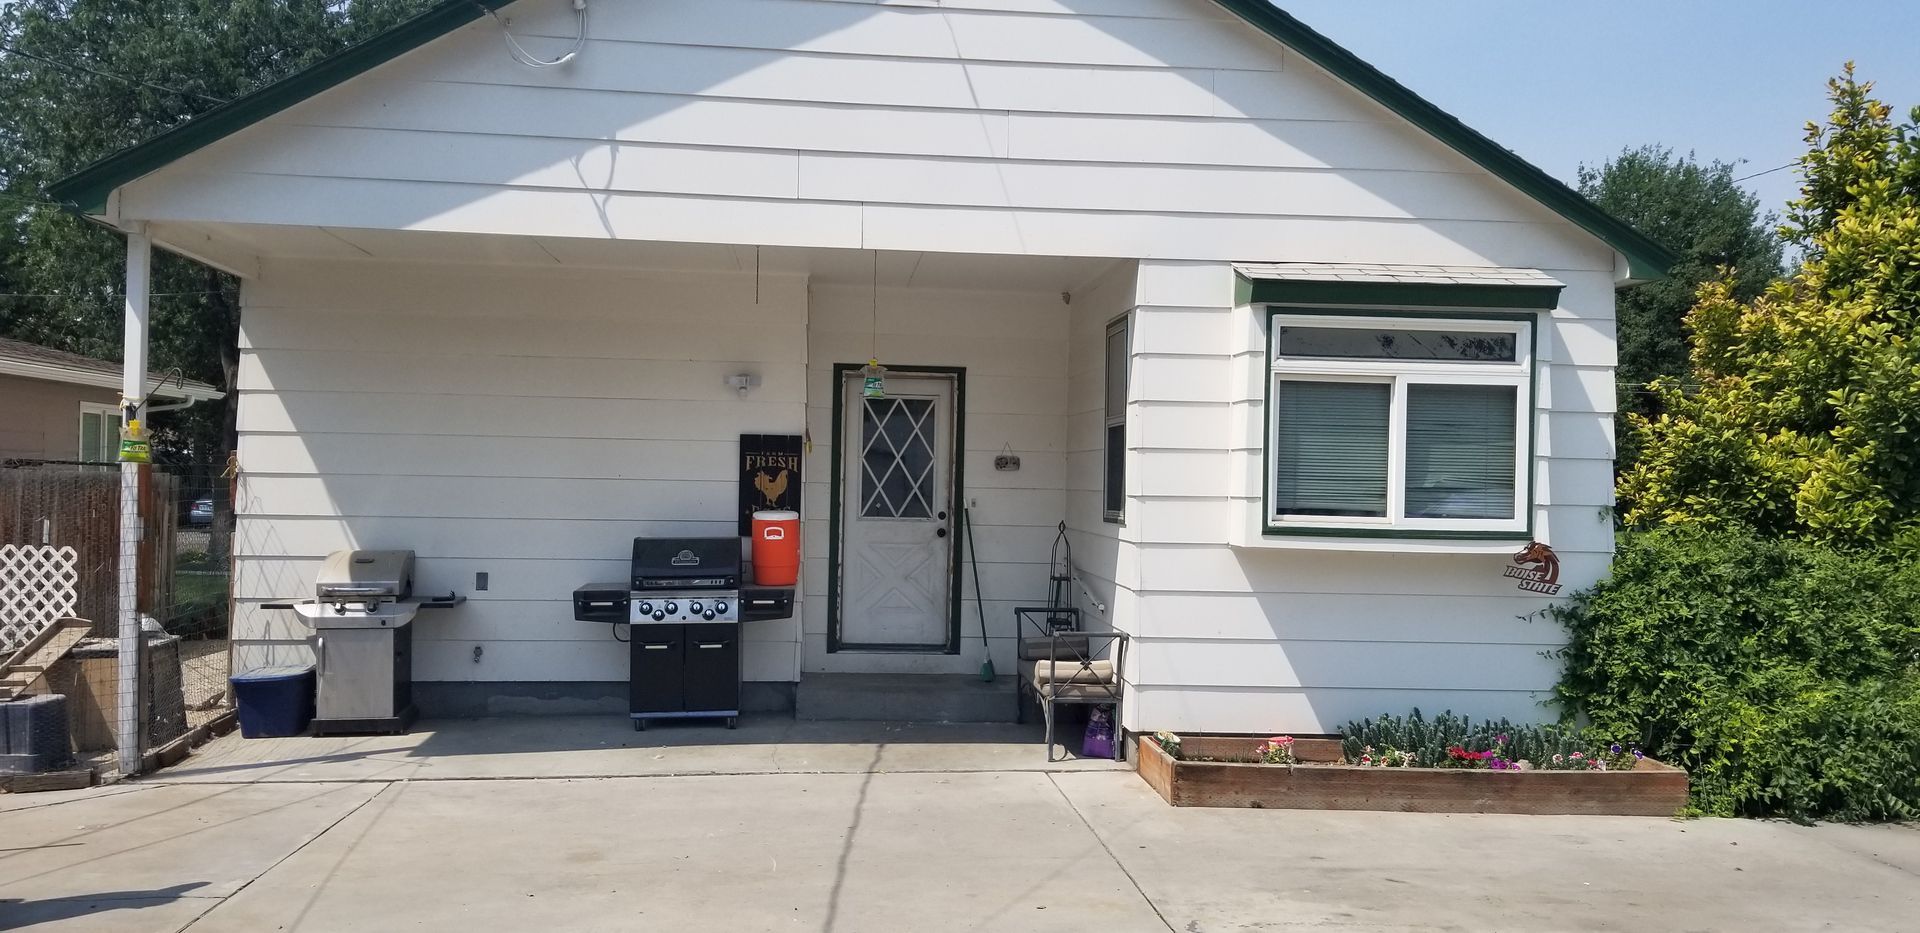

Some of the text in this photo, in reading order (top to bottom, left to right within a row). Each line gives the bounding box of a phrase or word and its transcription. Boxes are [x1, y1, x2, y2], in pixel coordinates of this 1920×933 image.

[745, 455, 799, 472] FRESH
[1504, 566, 1545, 580] BOISE
[1519, 580, 1561, 595] STATE
